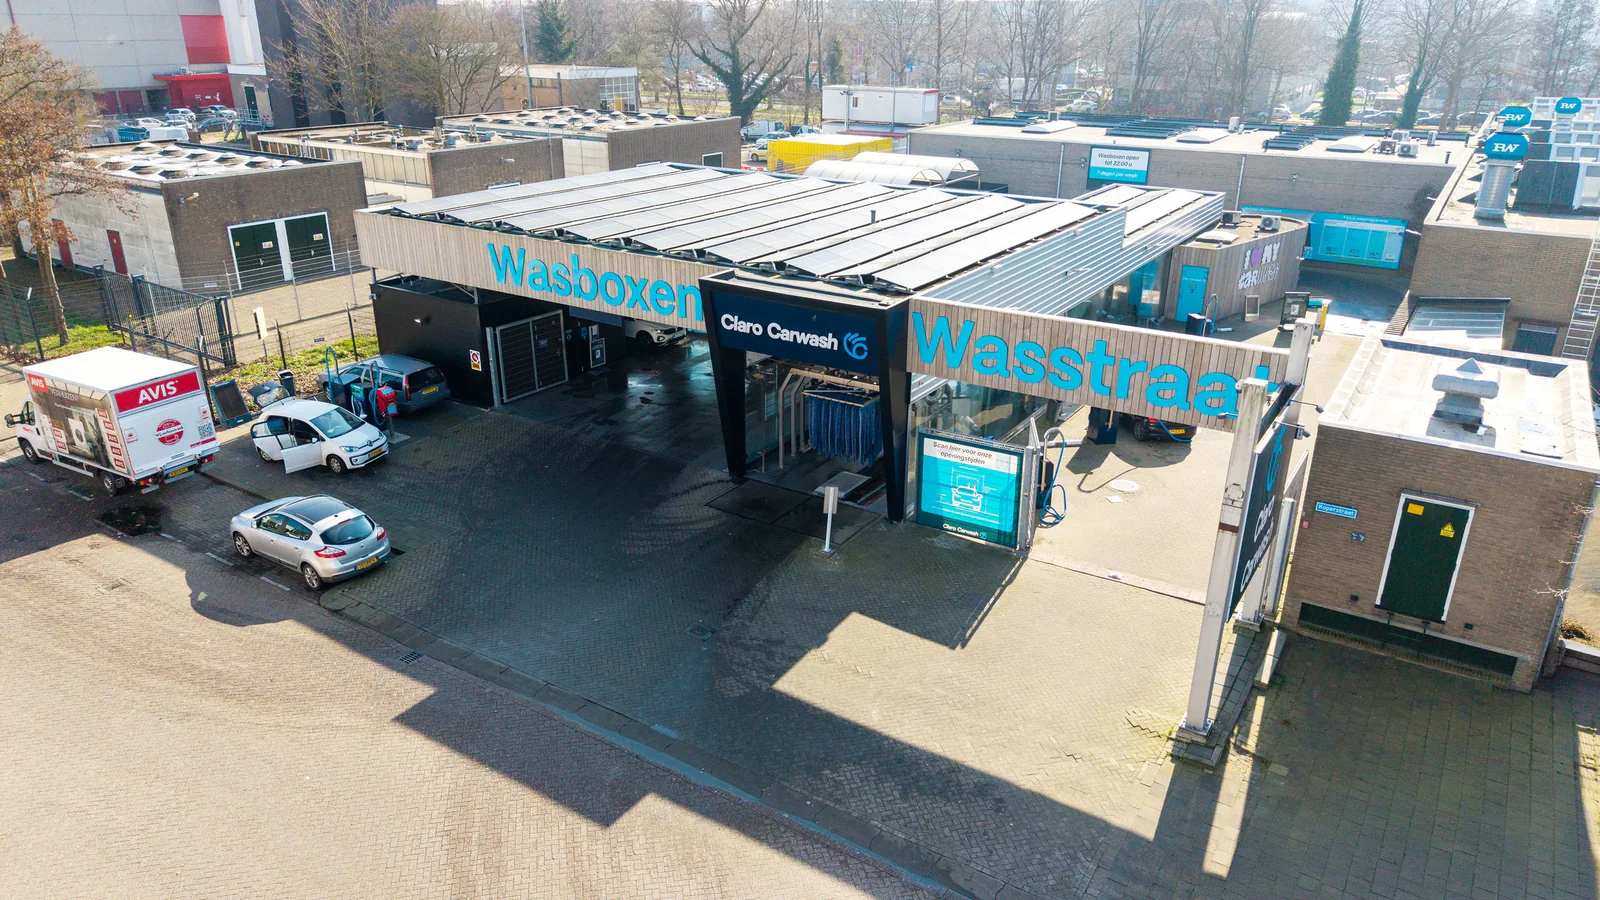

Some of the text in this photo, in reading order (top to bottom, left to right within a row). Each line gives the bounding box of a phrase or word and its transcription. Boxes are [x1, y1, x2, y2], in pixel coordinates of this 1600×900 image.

[487, 242, 704, 322] Wasboxen
[720, 313, 839, 350] Claro Carwash
[30, 377, 45, 388] AVIS
[138, 380, 177, 404] AVIS
[933, 441, 949, 449] Scan
[940, 451, 985, 465] openingstijden
[1318, 504, 1354, 516] Koperstraat
[942, 523, 979, 537] Claro Carwash
